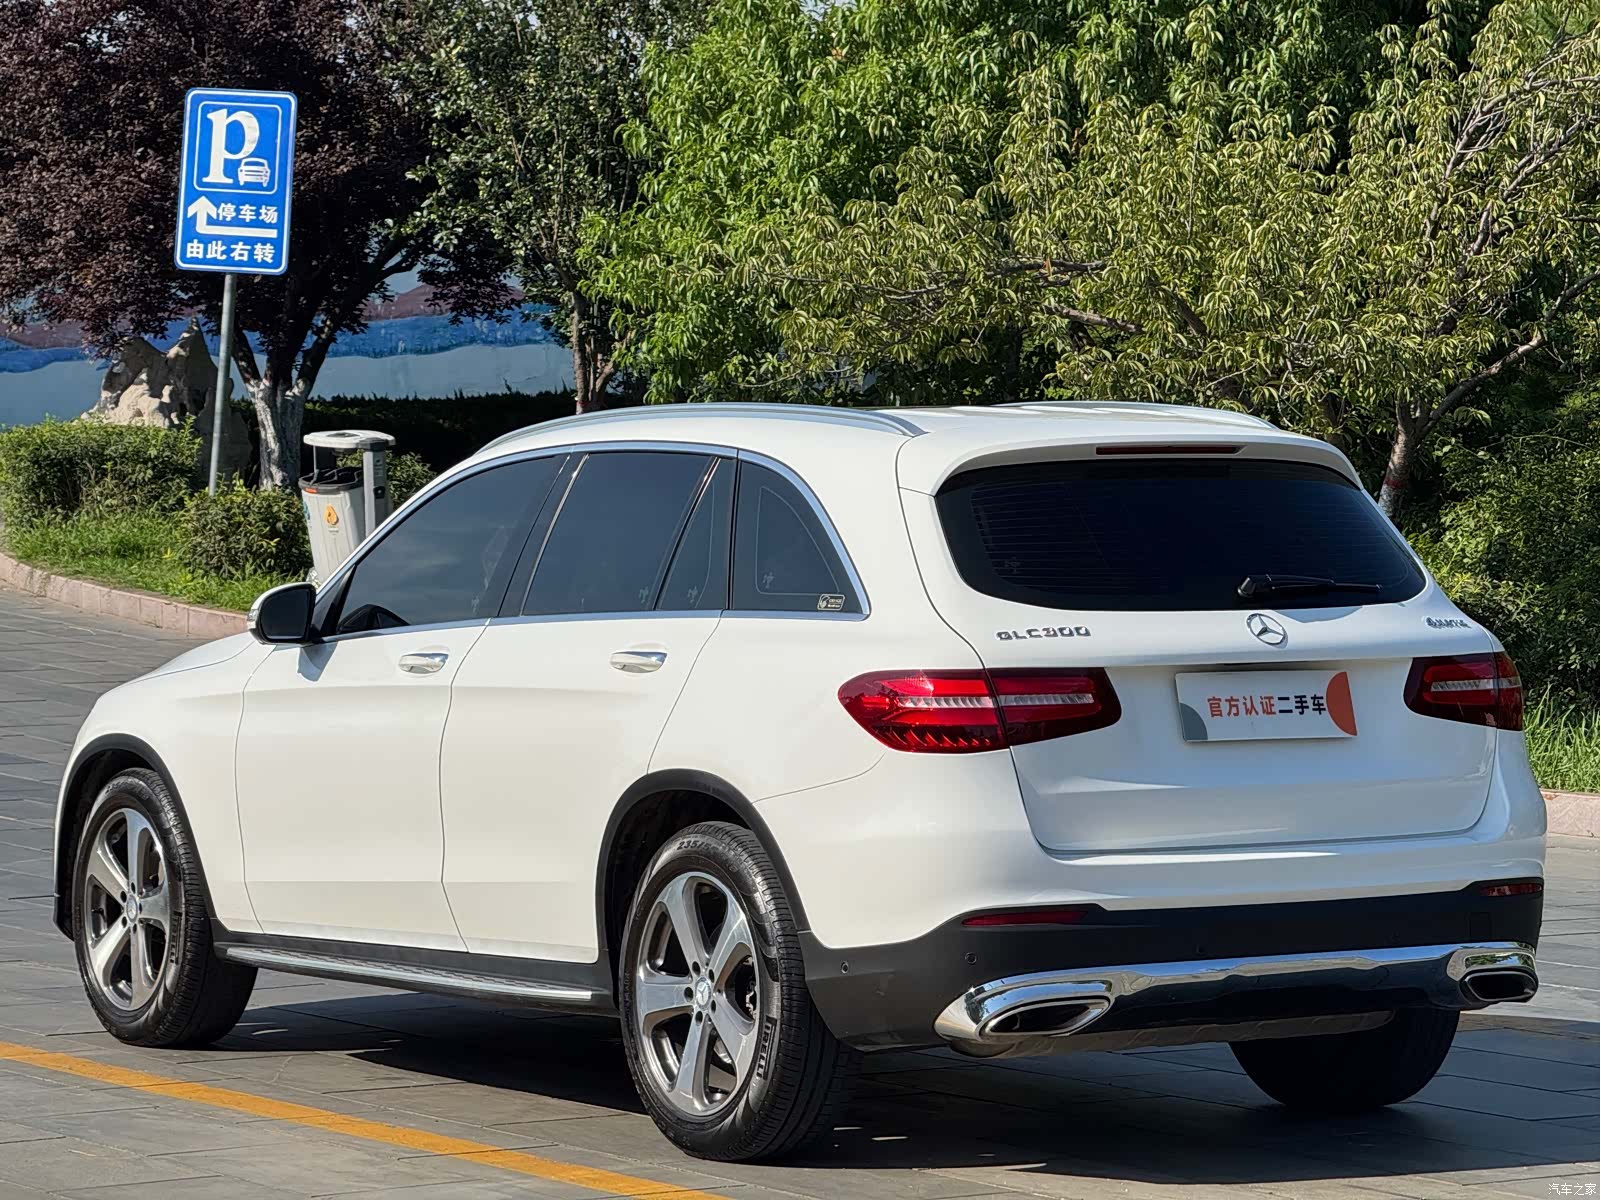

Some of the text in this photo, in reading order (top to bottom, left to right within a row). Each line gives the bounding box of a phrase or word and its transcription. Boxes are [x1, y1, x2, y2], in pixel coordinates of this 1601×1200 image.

[217, 202, 278, 224] 停车场
[186, 239, 275, 263] 由此右转
[1207, 694, 1327, 718] 官方认证二手车
